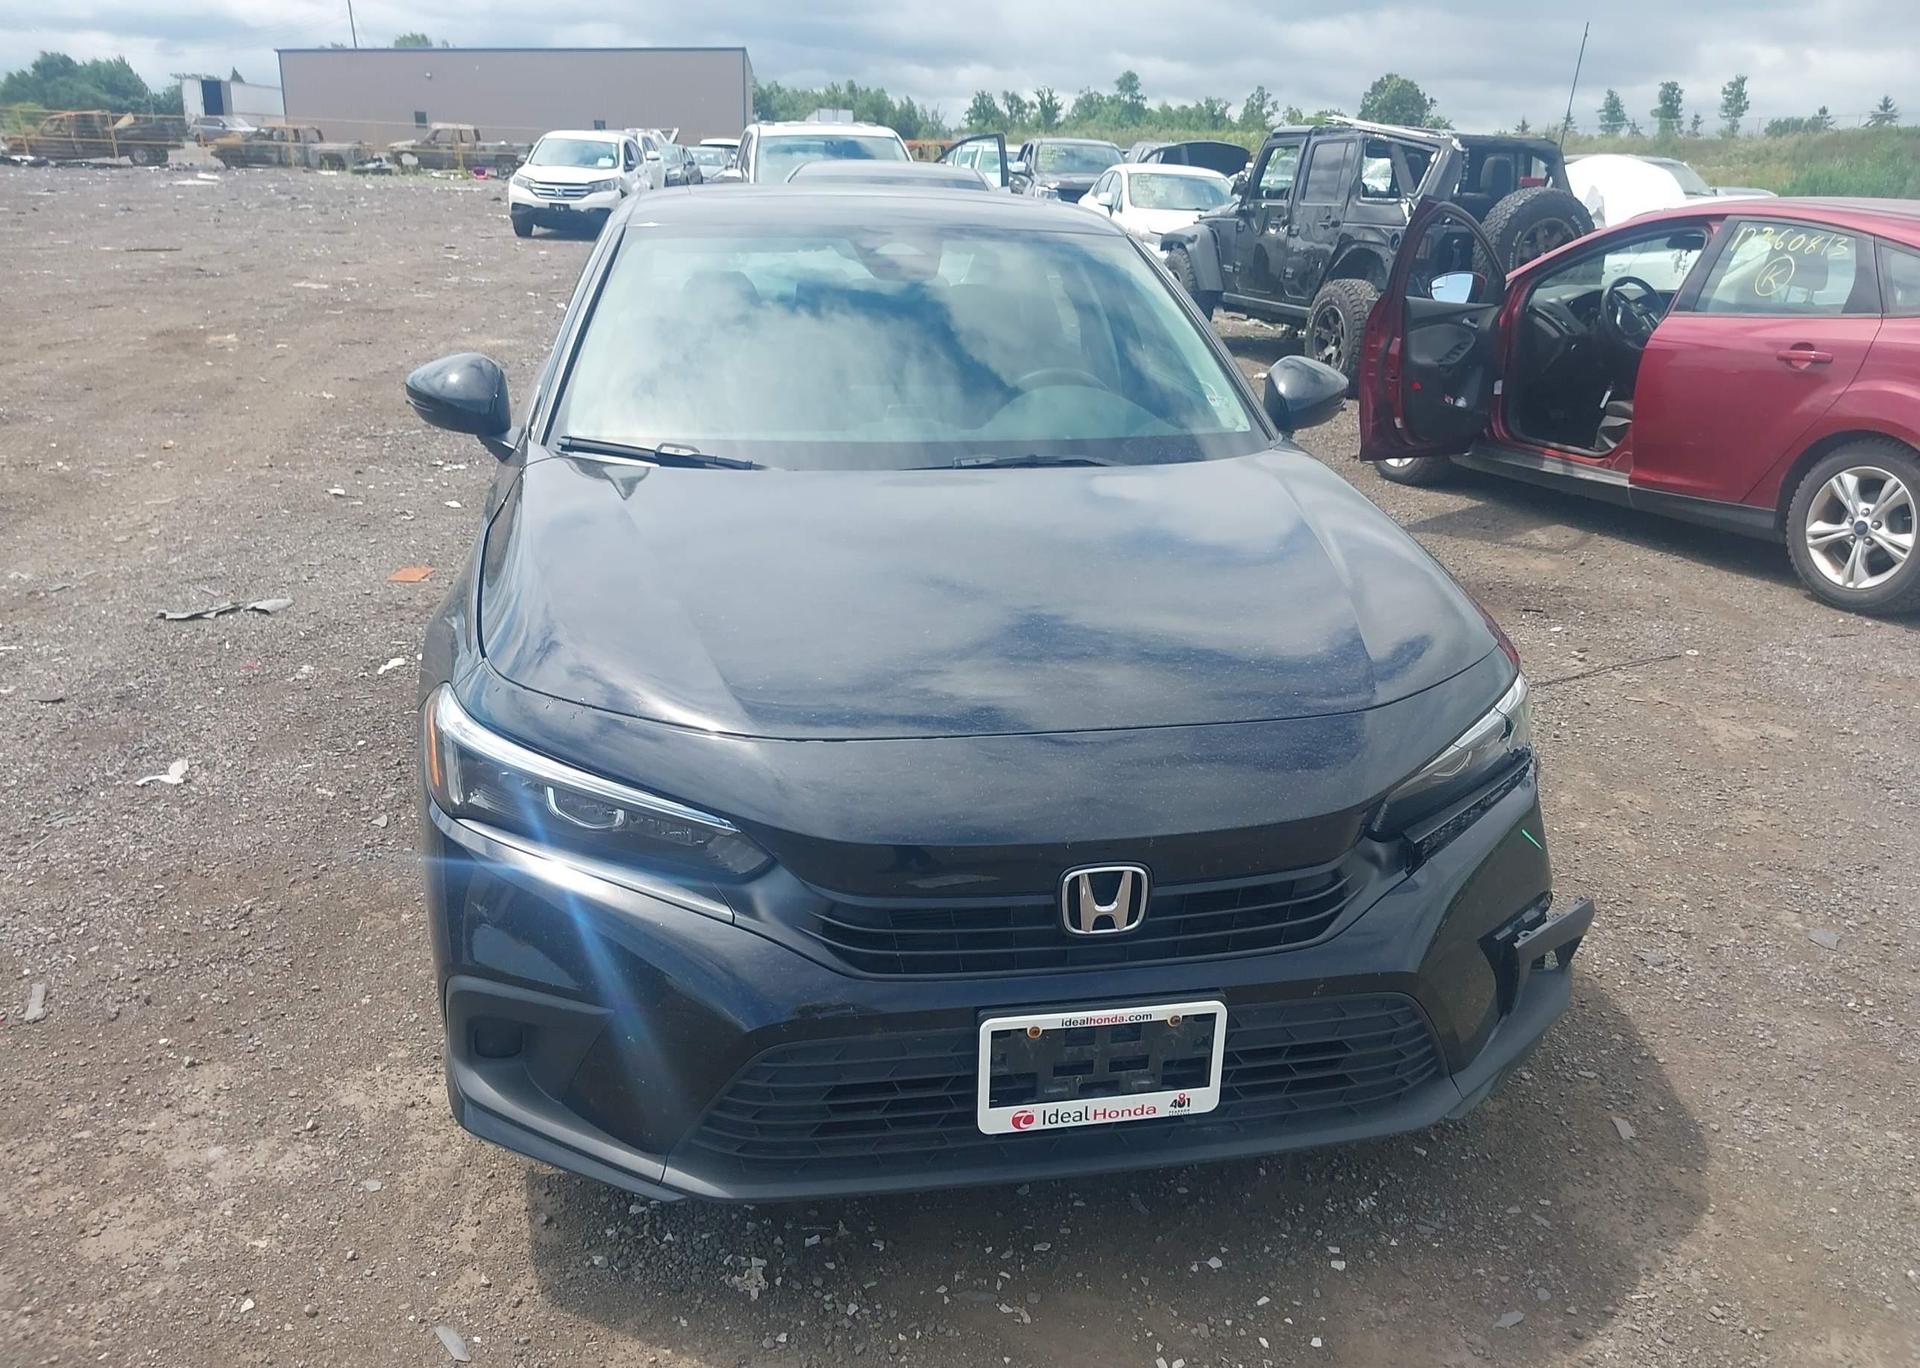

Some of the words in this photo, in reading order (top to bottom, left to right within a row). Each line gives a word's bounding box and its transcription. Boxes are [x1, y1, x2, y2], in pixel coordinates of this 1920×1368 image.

[1061, 1012, 1153, 1027] idealhonda.com
[1042, 1105, 1090, 1126] Ideal
[1092, 1103, 1158, 1121] Honda
